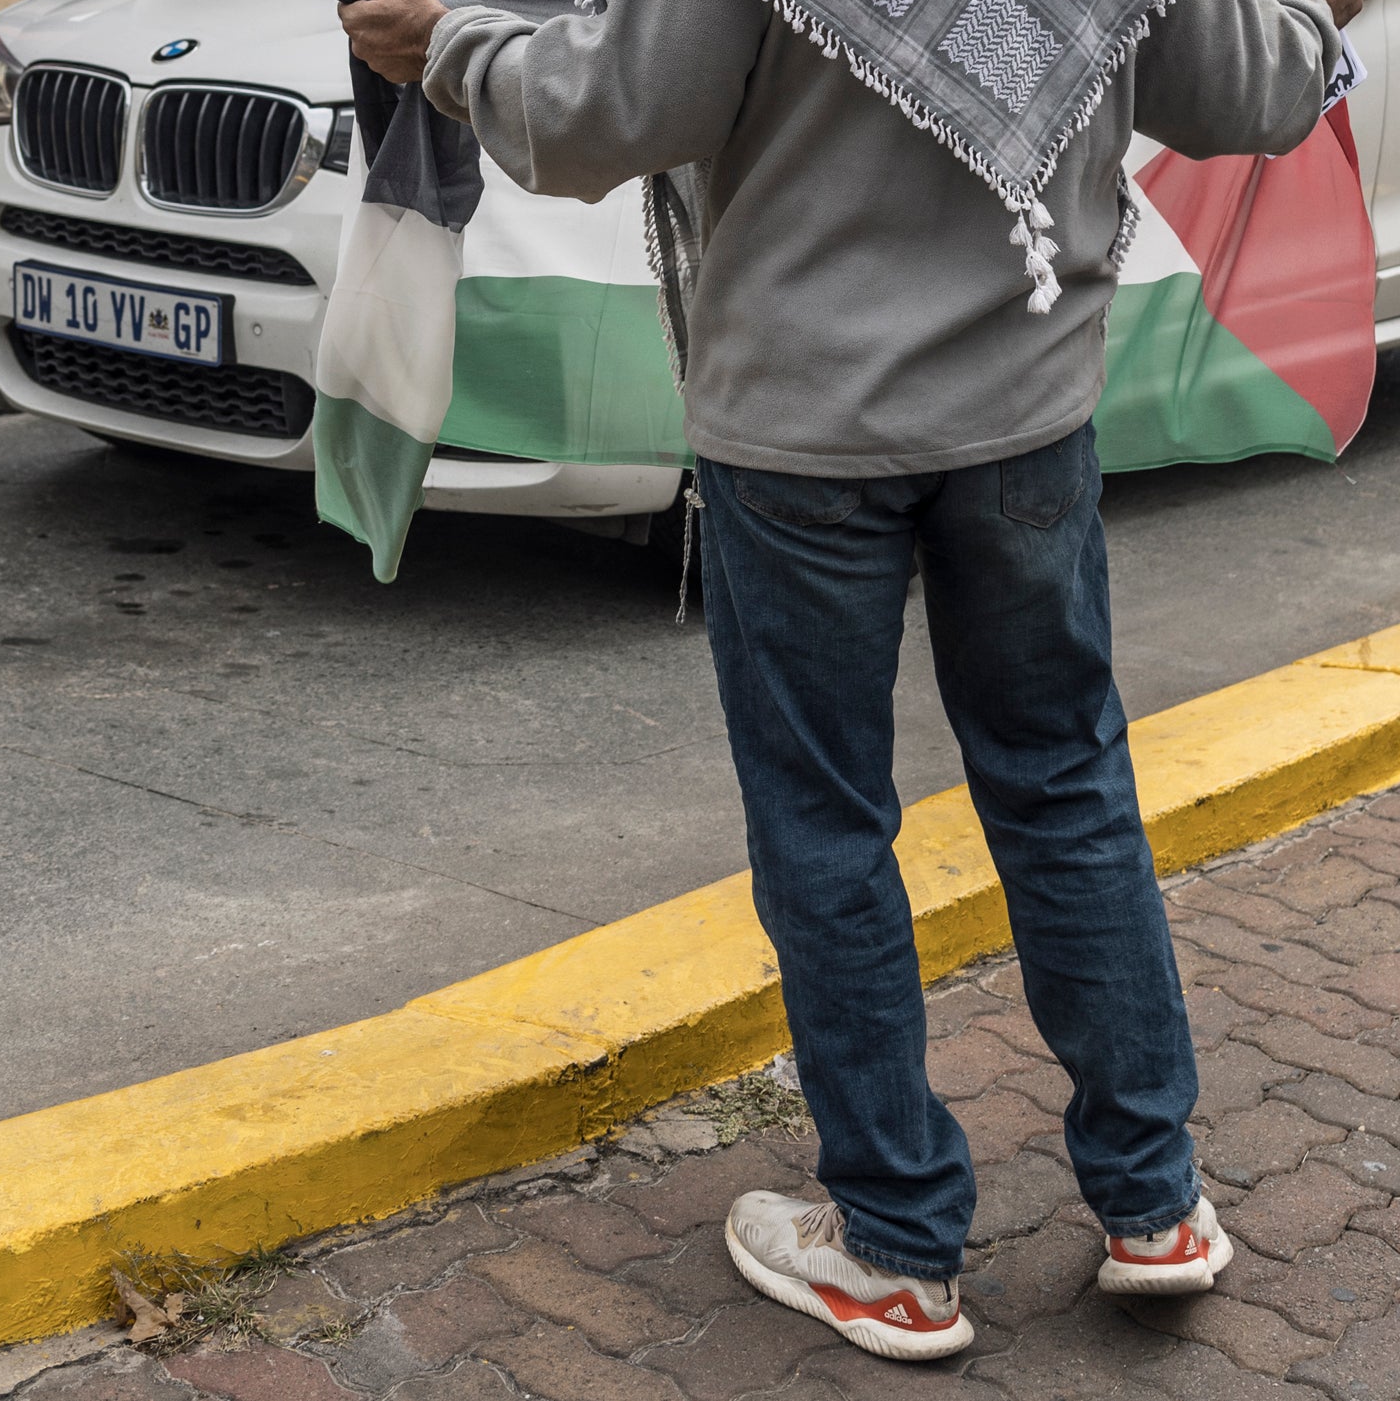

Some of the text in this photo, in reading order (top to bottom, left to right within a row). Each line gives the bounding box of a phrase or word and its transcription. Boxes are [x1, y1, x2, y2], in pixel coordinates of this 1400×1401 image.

[21, 273, 211, 353] DW 10 YV GP
[884, 1311, 913, 1325] adidas
